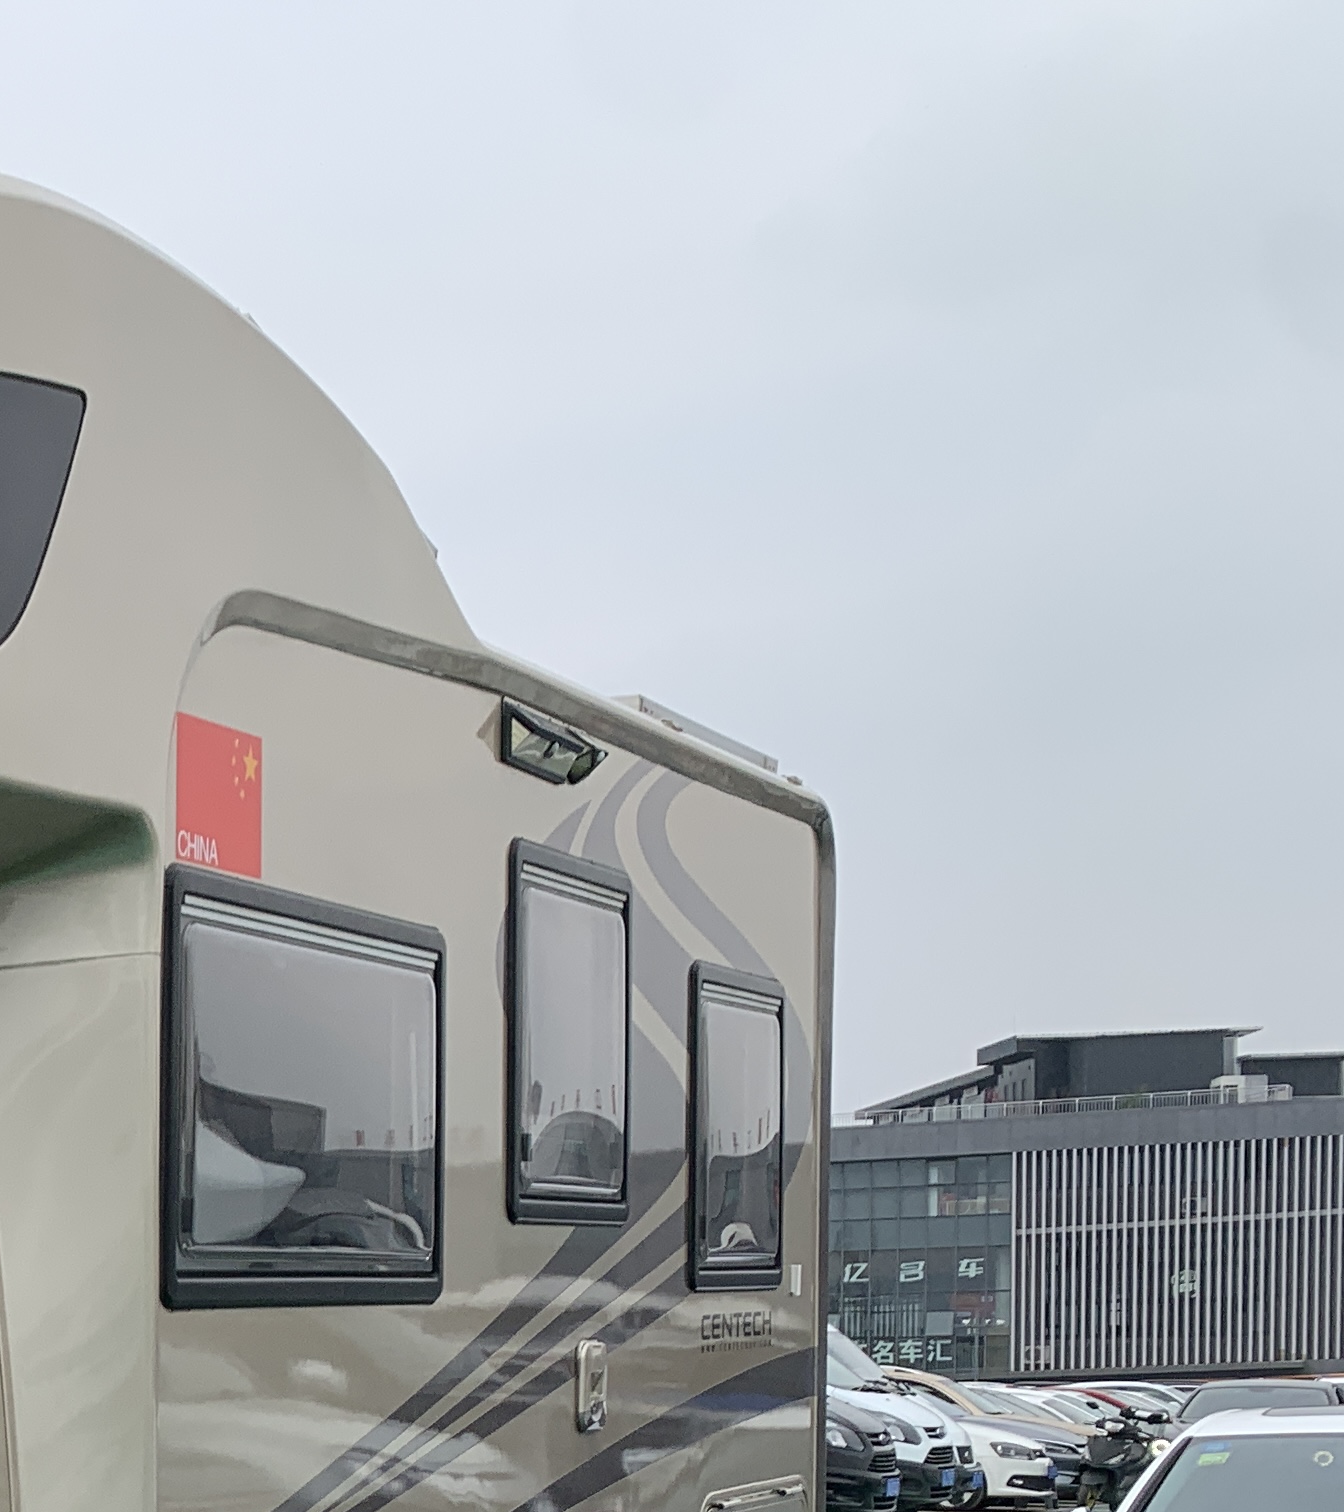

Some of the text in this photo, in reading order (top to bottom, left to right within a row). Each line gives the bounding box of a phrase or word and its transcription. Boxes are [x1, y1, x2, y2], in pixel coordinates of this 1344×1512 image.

[177, 830, 219, 865] CHINA
[700, 1311, 772, 1341] CENTECH
[858, 1338, 953, 1364] 名车汇
